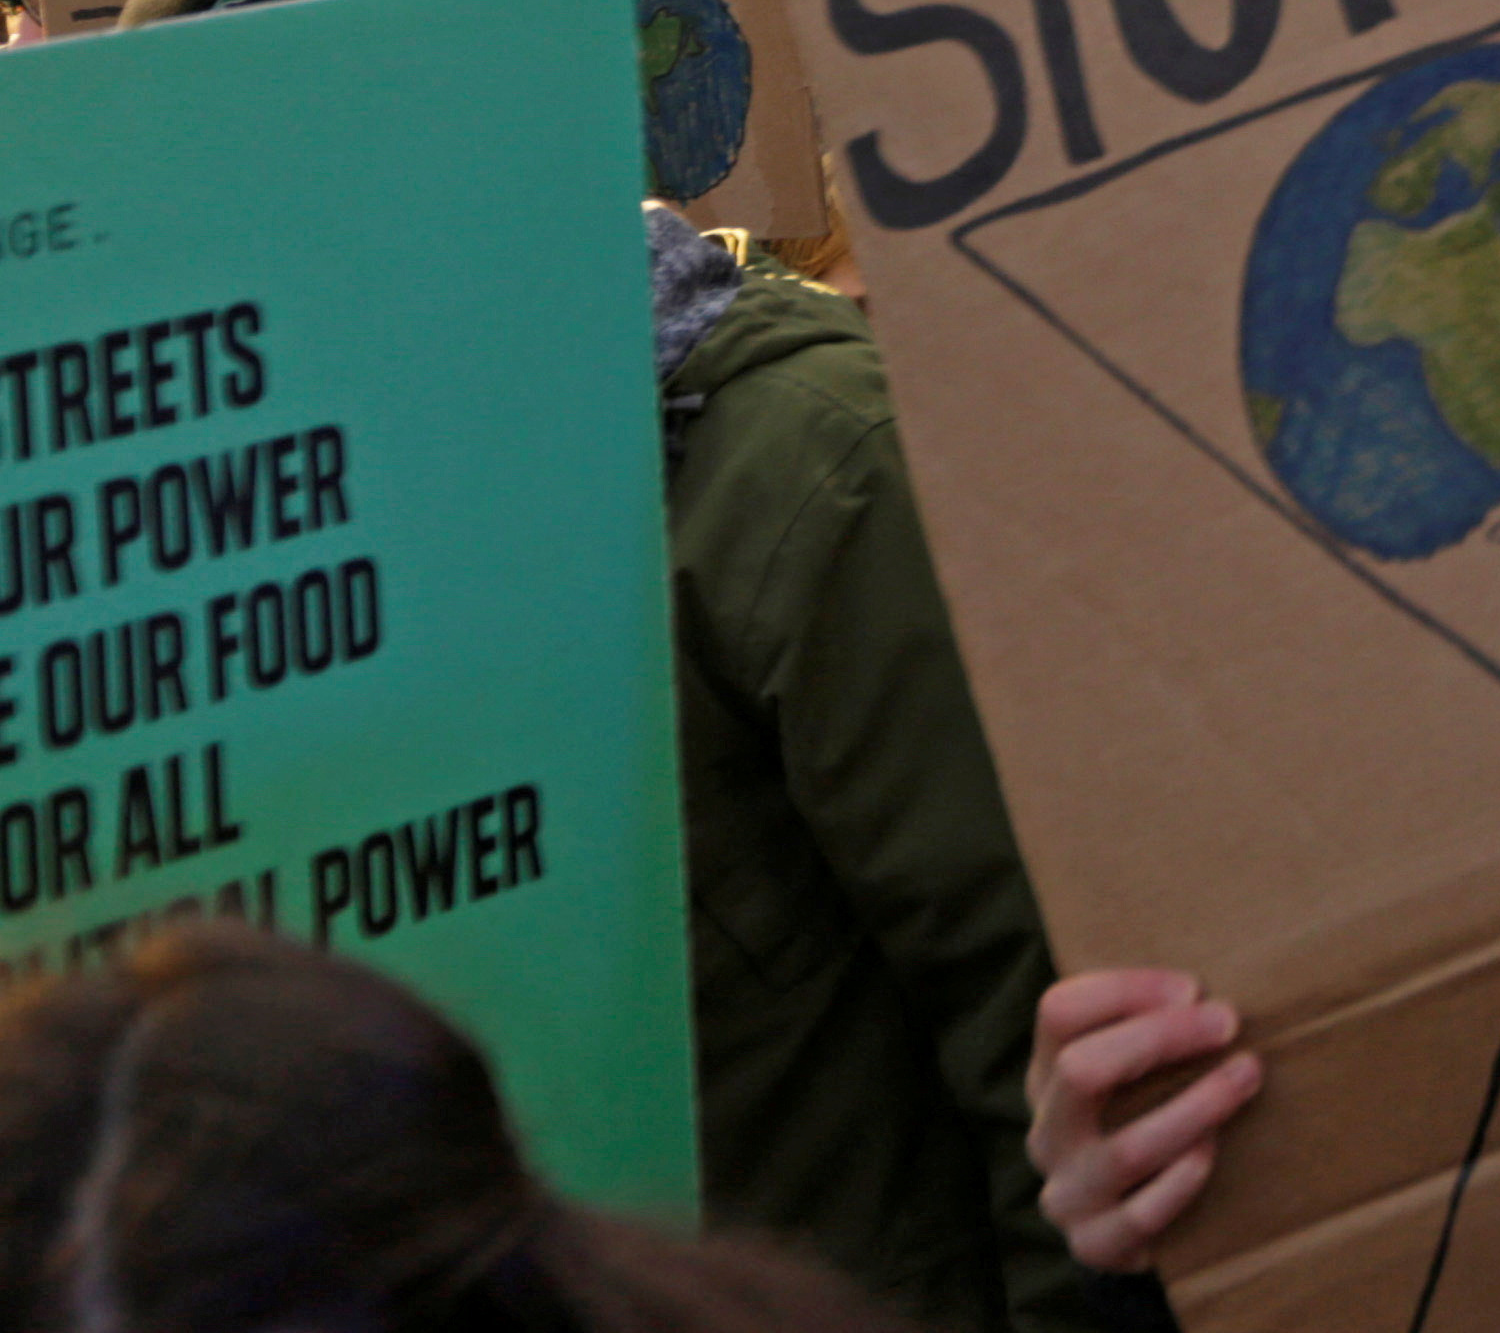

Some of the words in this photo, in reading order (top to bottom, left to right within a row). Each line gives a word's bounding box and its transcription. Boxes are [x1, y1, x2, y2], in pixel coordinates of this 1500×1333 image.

[0, 300, 266, 460] TREETS
[0, 491, 79, 616] UR
[97, 423, 350, 586] POWER
[40, 611, 190, 755] OUR
[207, 555, 381, 704] FOOD
[0, 784, 94, 914] OR
[114, 741, 246, 882] ALL
[310, 782, 544, 950] POWER
